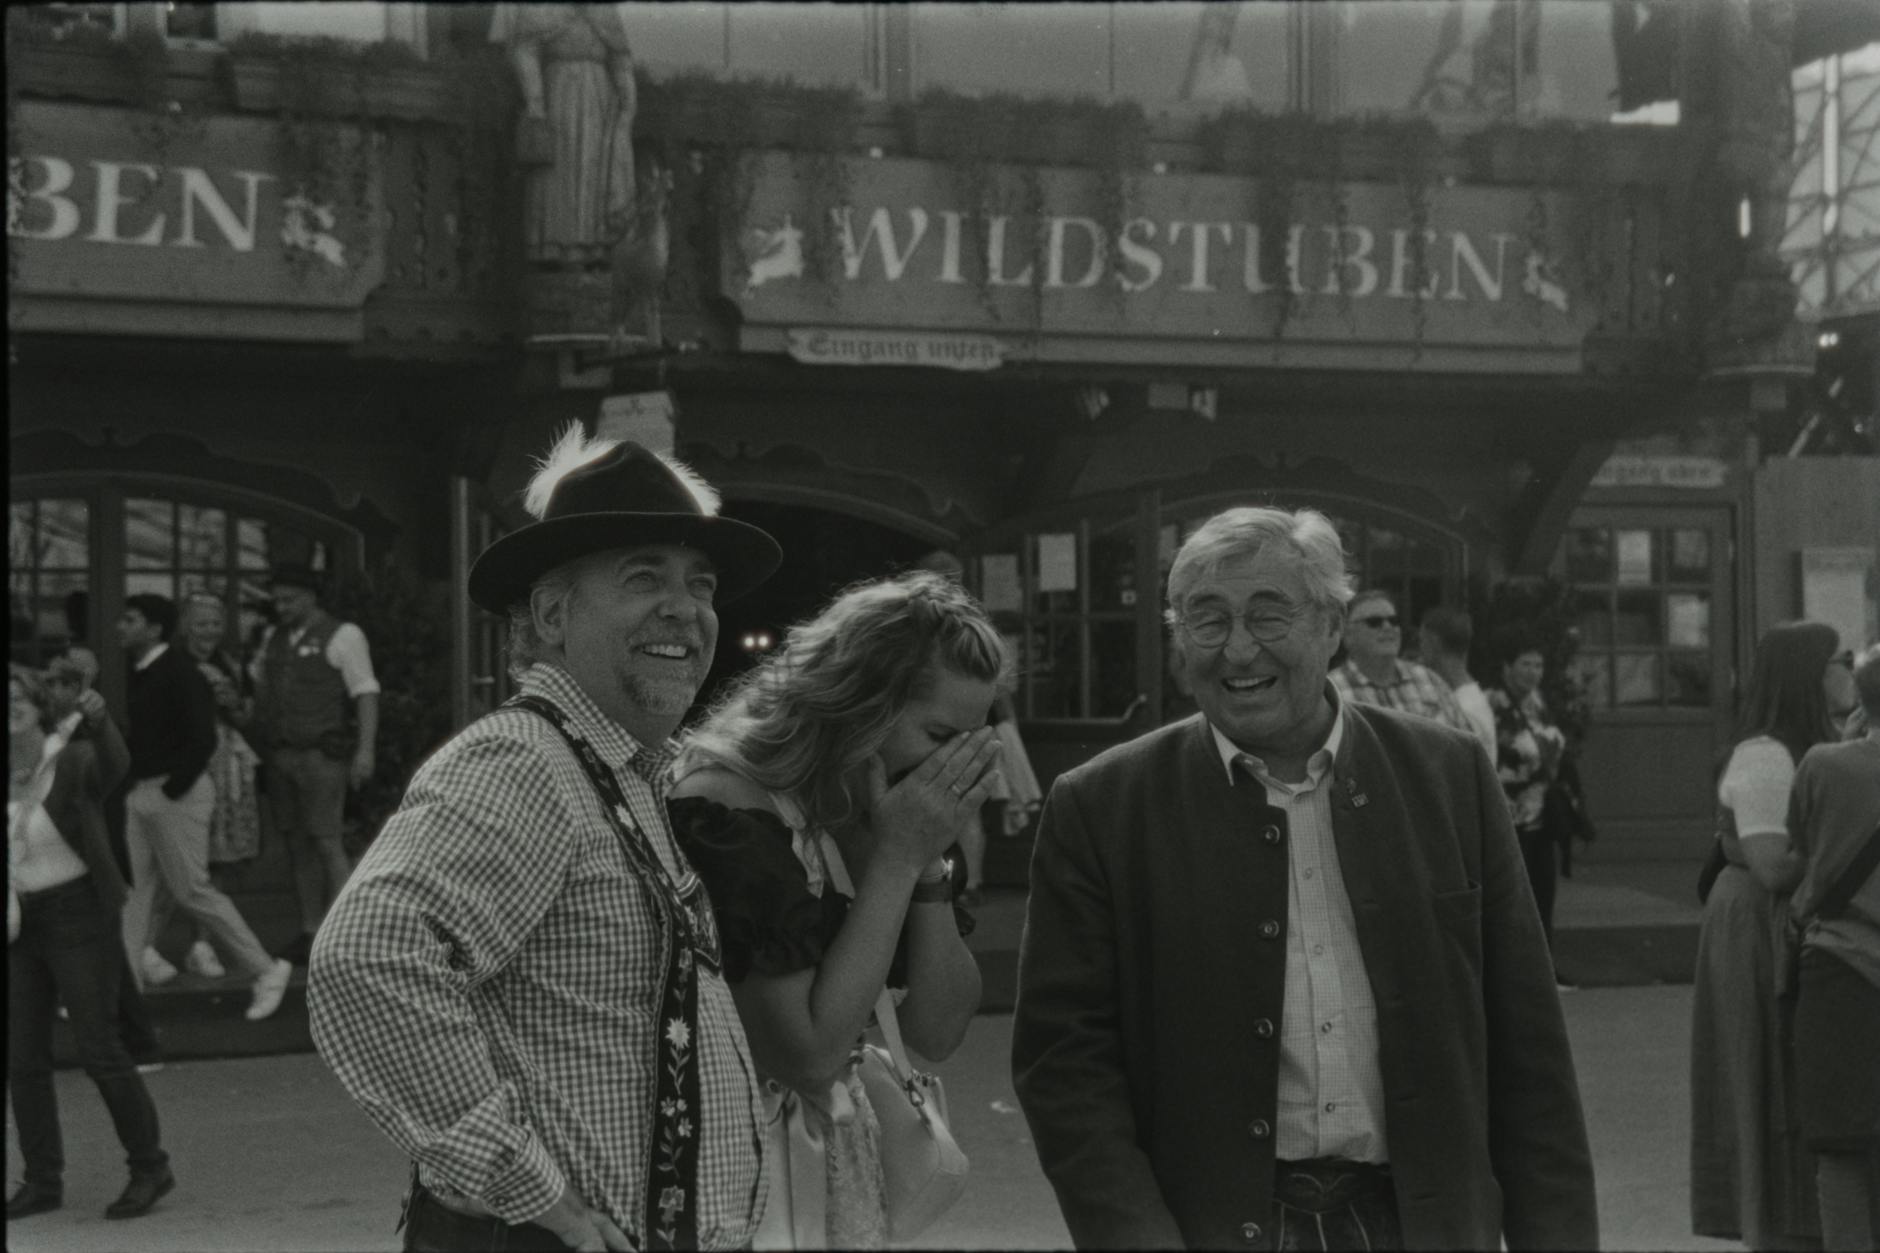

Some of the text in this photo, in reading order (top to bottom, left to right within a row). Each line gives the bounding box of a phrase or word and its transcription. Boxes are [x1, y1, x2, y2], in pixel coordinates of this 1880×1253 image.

[8, 154, 276, 252] BEN
[831, 206, 1516, 303] WILDSTUBEN
[808, 330, 918, 361] Eingang
